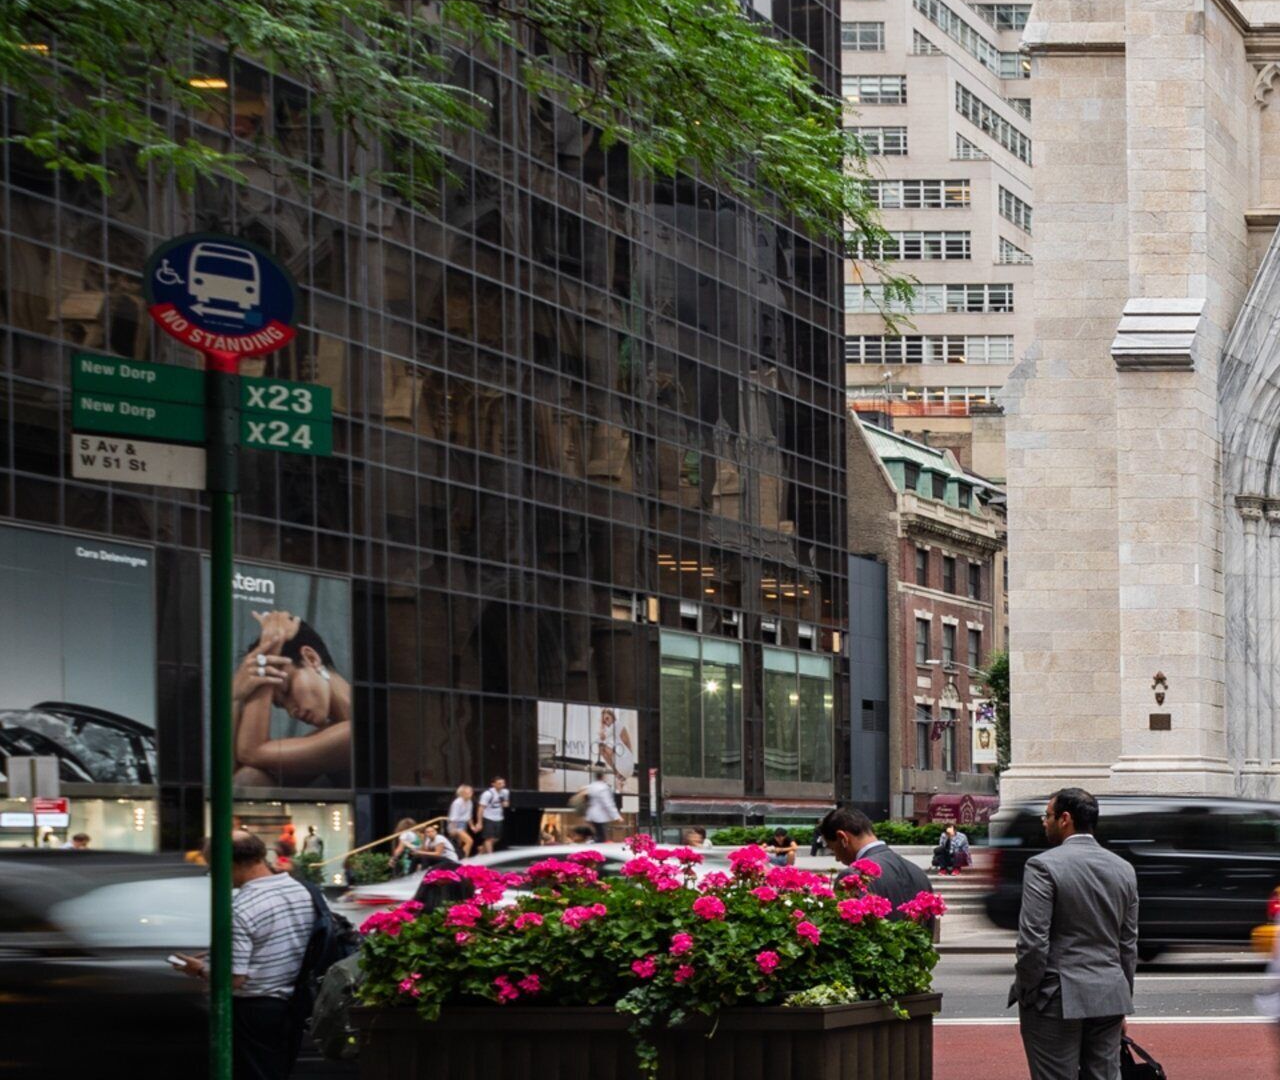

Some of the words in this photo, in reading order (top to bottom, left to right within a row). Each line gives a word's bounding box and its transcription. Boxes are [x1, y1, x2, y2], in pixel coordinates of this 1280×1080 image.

[160, 309, 188, 332] NO
[189, 326, 284, 352] STANDING
[81, 360, 115, 376] New
[119, 365, 156, 383] Dorp
[81, 397, 115, 413] New
[119, 402, 156, 420] Dorp
[247, 385, 313, 414] X23
[247, 421, 313, 449] X24
[80, 439, 90, 451] 5
[97, 441, 119, 454] Av
[125, 443, 136, 456] &
[81, 454, 96, 467] W
[102, 456, 121, 469] 51
[129, 459, 147, 472] St
